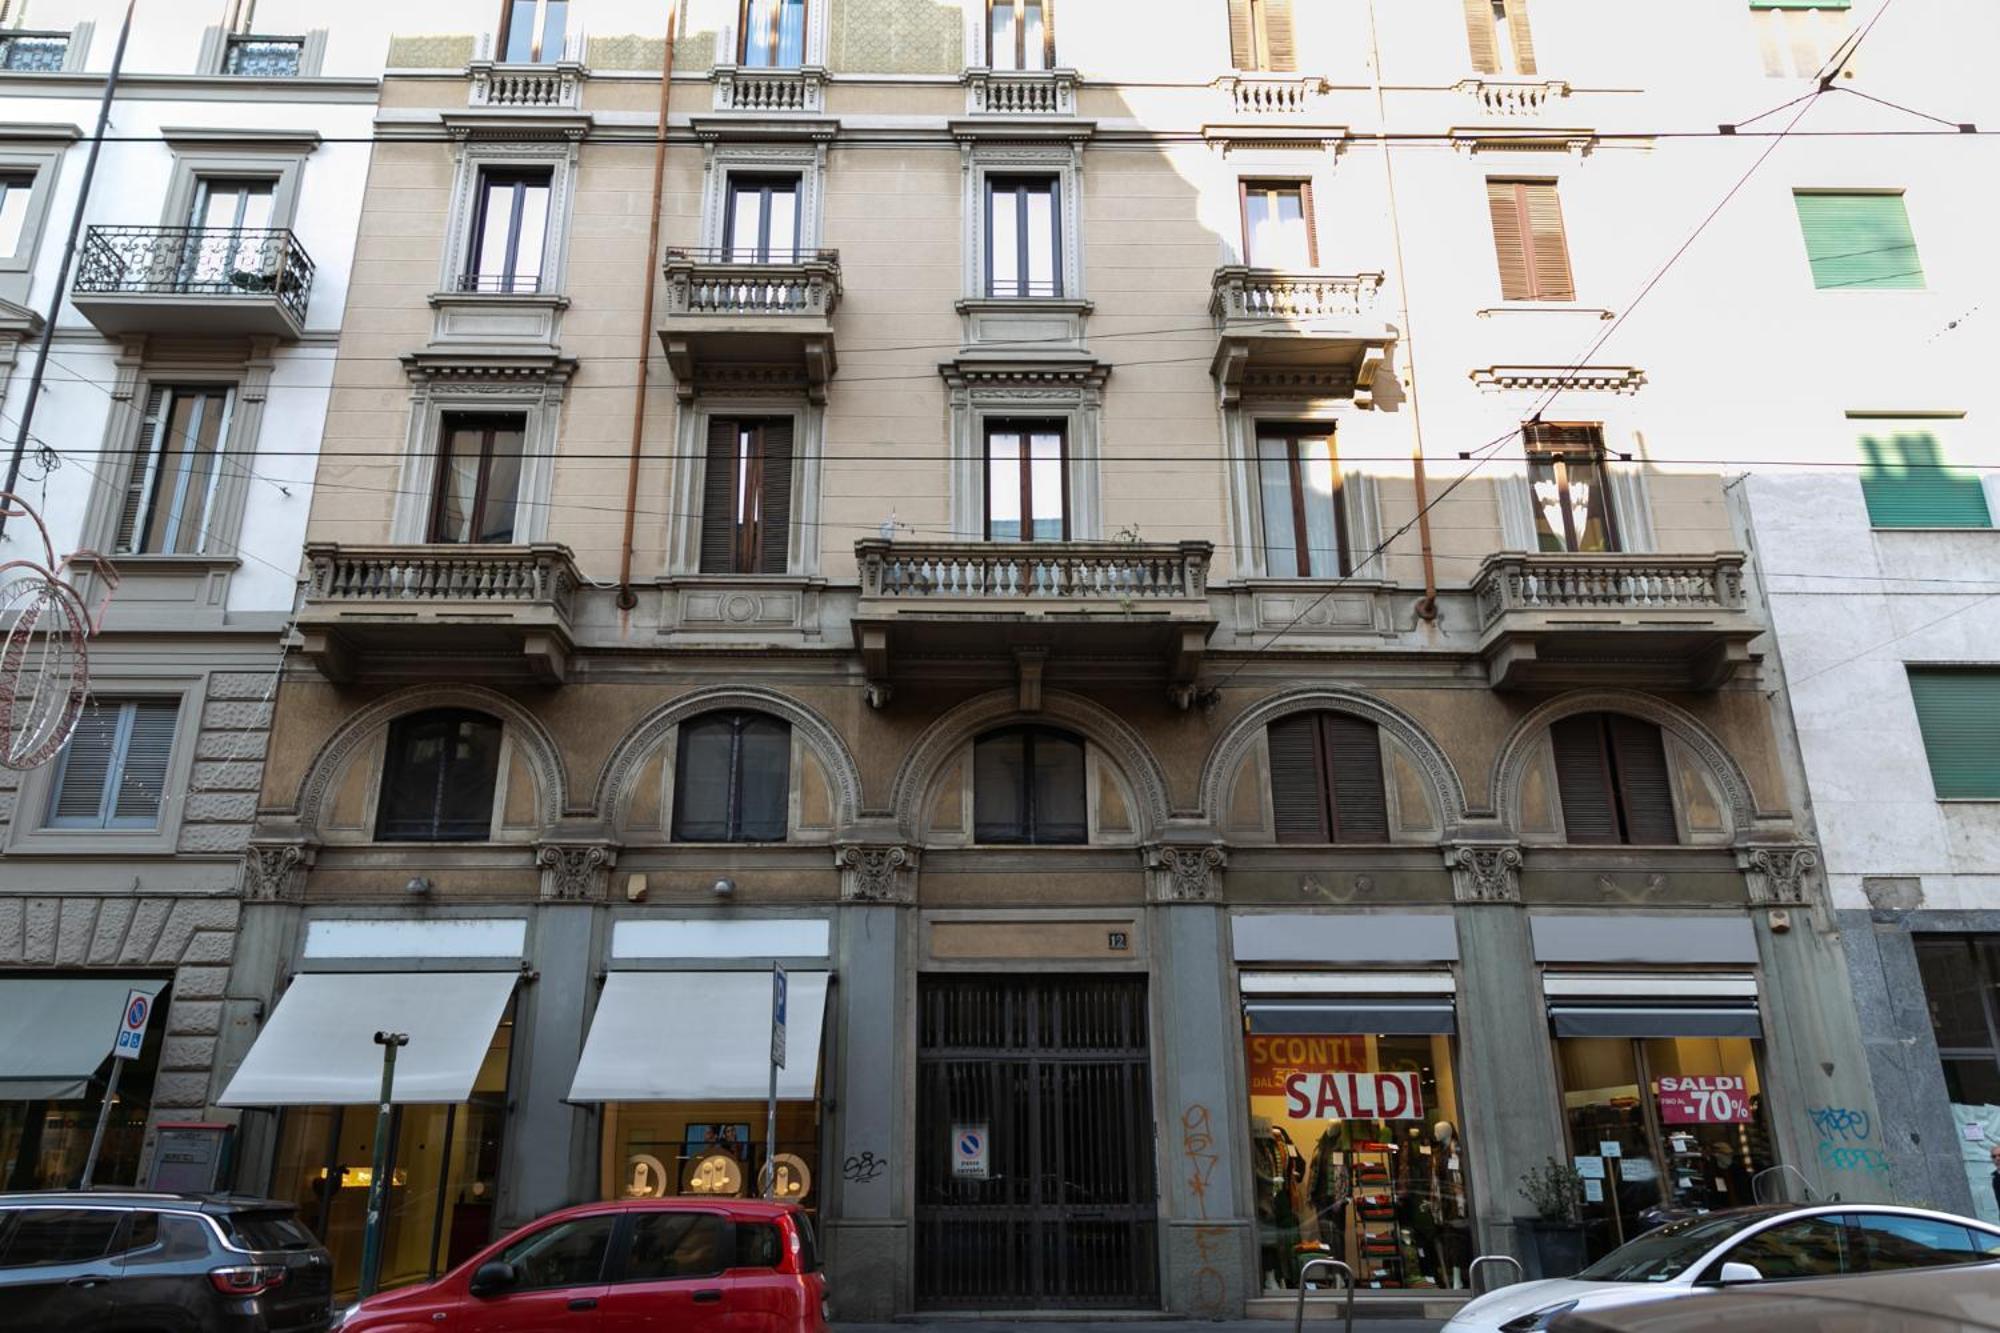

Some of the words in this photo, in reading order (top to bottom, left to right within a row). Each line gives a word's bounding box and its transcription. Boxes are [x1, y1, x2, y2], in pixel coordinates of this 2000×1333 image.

[1111, 934, 1125, 948] 12
[1252, 1037, 1352, 1066] SCONTI
[1253, 1077, 1273, 1089] DAL
[1660, 1076, 1744, 1092] SALDI
[1285, 1073, 1424, 1120] SALDI
[1684, 1090, 1749, 1121] -70%
